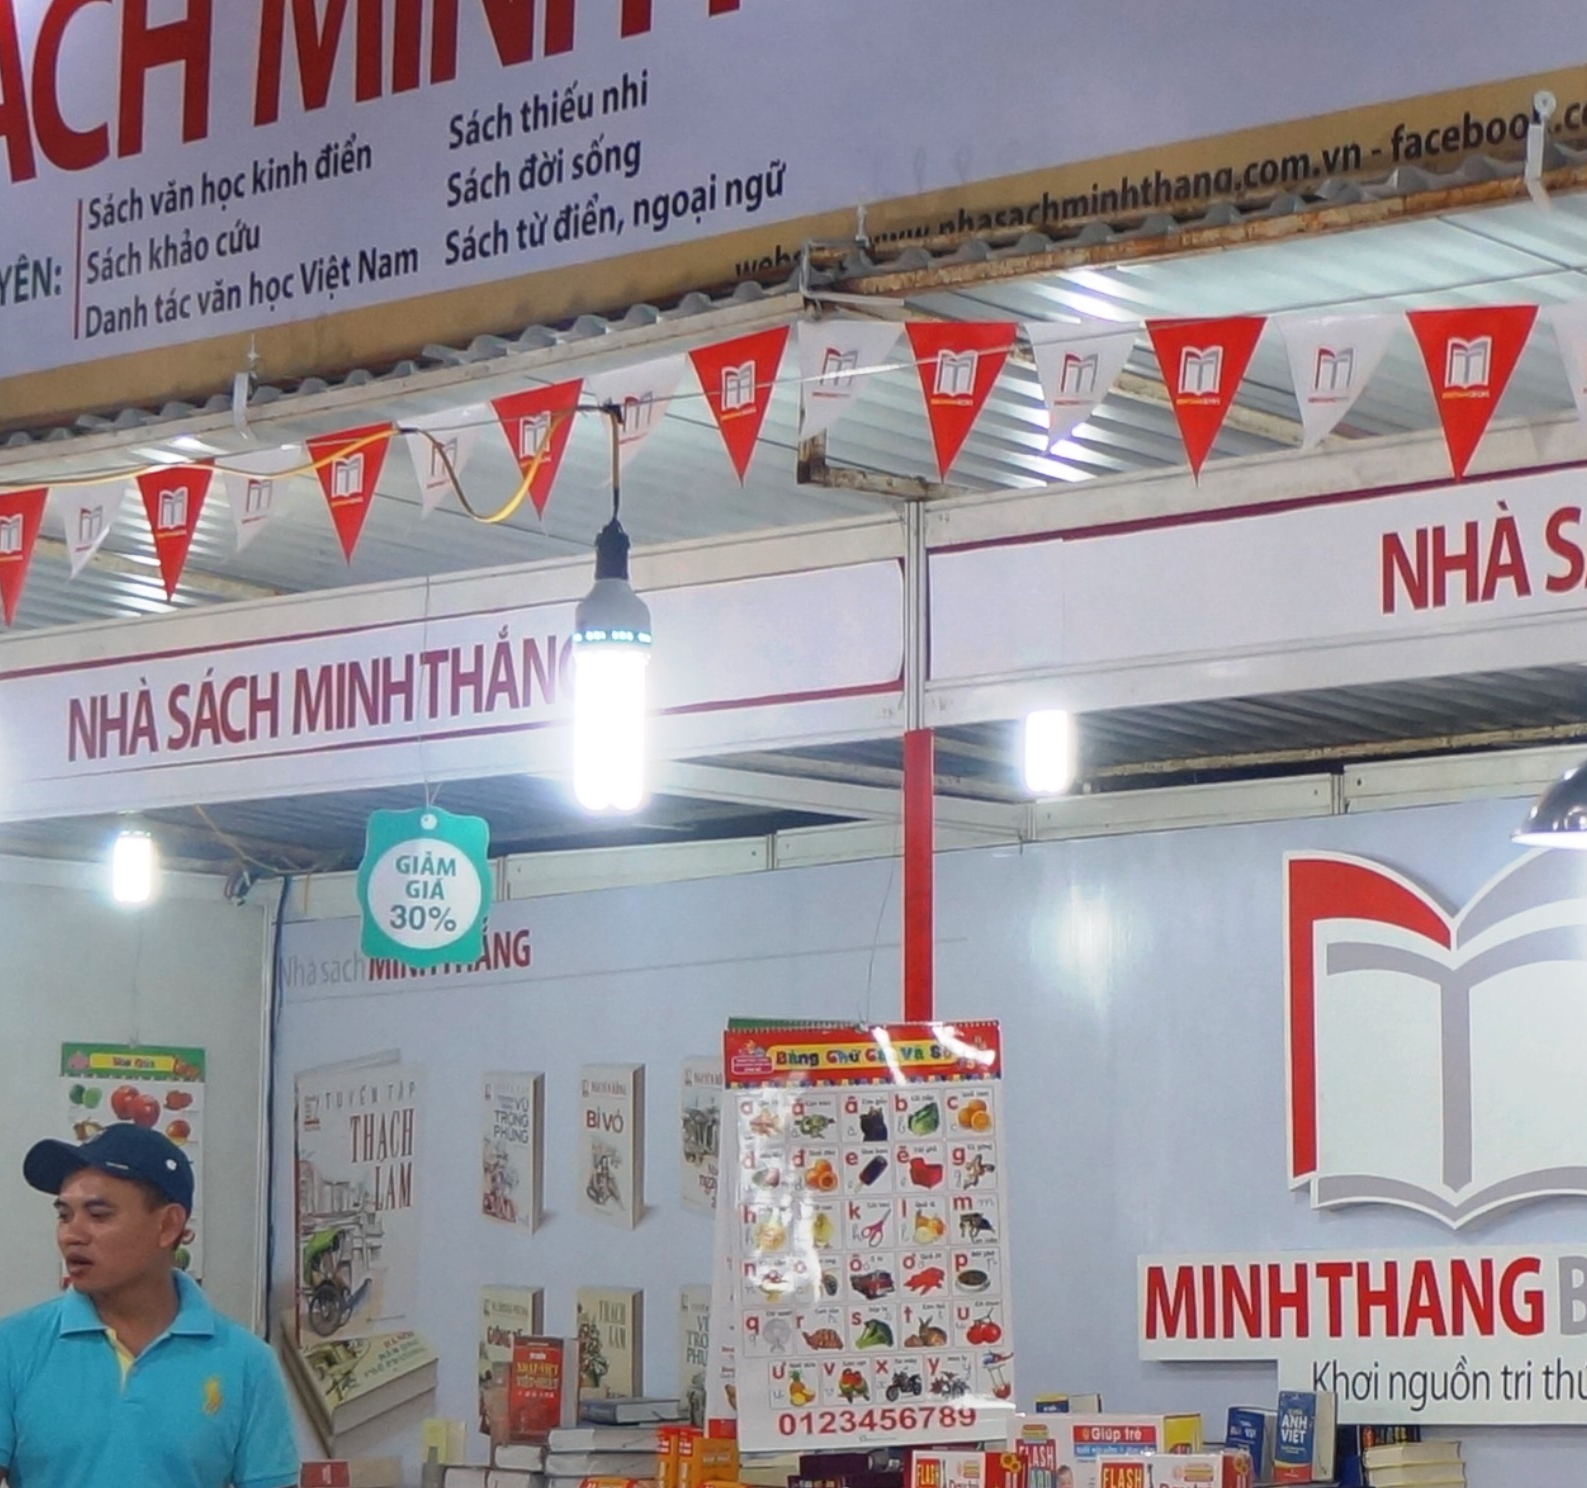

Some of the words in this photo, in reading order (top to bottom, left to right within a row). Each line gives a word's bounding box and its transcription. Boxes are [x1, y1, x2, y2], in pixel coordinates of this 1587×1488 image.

[449, 104, 513, 150] Sách
[519, 80, 594, 134] thiếu
[601, 69, 649, 113] nhi
[87, 194, 143, 231] Sách
[150, 178, 194, 212] văn
[199, 163, 246, 208] học
[252, 150, 308, 195] kinh
[315, 132, 373, 180] điển
[446, 162, 511, 208] Sách
[517, 147, 565, 192] đời
[570, 136, 642, 185] sống
[445, 219, 512, 266] Sách
[515, 212, 548, 249] từ
[552, 191, 625, 245] điển,
[631, 180, 716, 236] ngoại
[723, 158, 788, 212] ngữ
[86, 249, 141, 284] Sách
[148, 225, 209, 276] khảo
[215, 217, 261, 255] cứu
[85, 300, 147, 338] Danh
[152, 286, 191, 326] tác
[198, 274, 242, 318] văn
[249, 267, 295, 311] học
[300, 249, 352, 301] Việt
[357, 243, 420, 283] Nam
[1380, 499, 1532, 614] NHÀ
[67, 688, 158, 762] NHÀ
[165, 667, 277, 752] SÁCH
[395, 851, 457, 877] GIẢM
[405, 878, 445, 900] GIÁ
[390, 904, 457, 933] 30%
[350, 1108, 415, 1166] THẠCH
[1313, 1360, 1381, 1402] Khơi
[1388, 1354, 1473, 1411] nguồn
[1501, 1361, 1532, 1402] tri
[778, 1406, 977, 1436] 0123456789
[1281, 1414, 1308, 1430] ANH
[917, 1462, 940, 1486] FLASH
